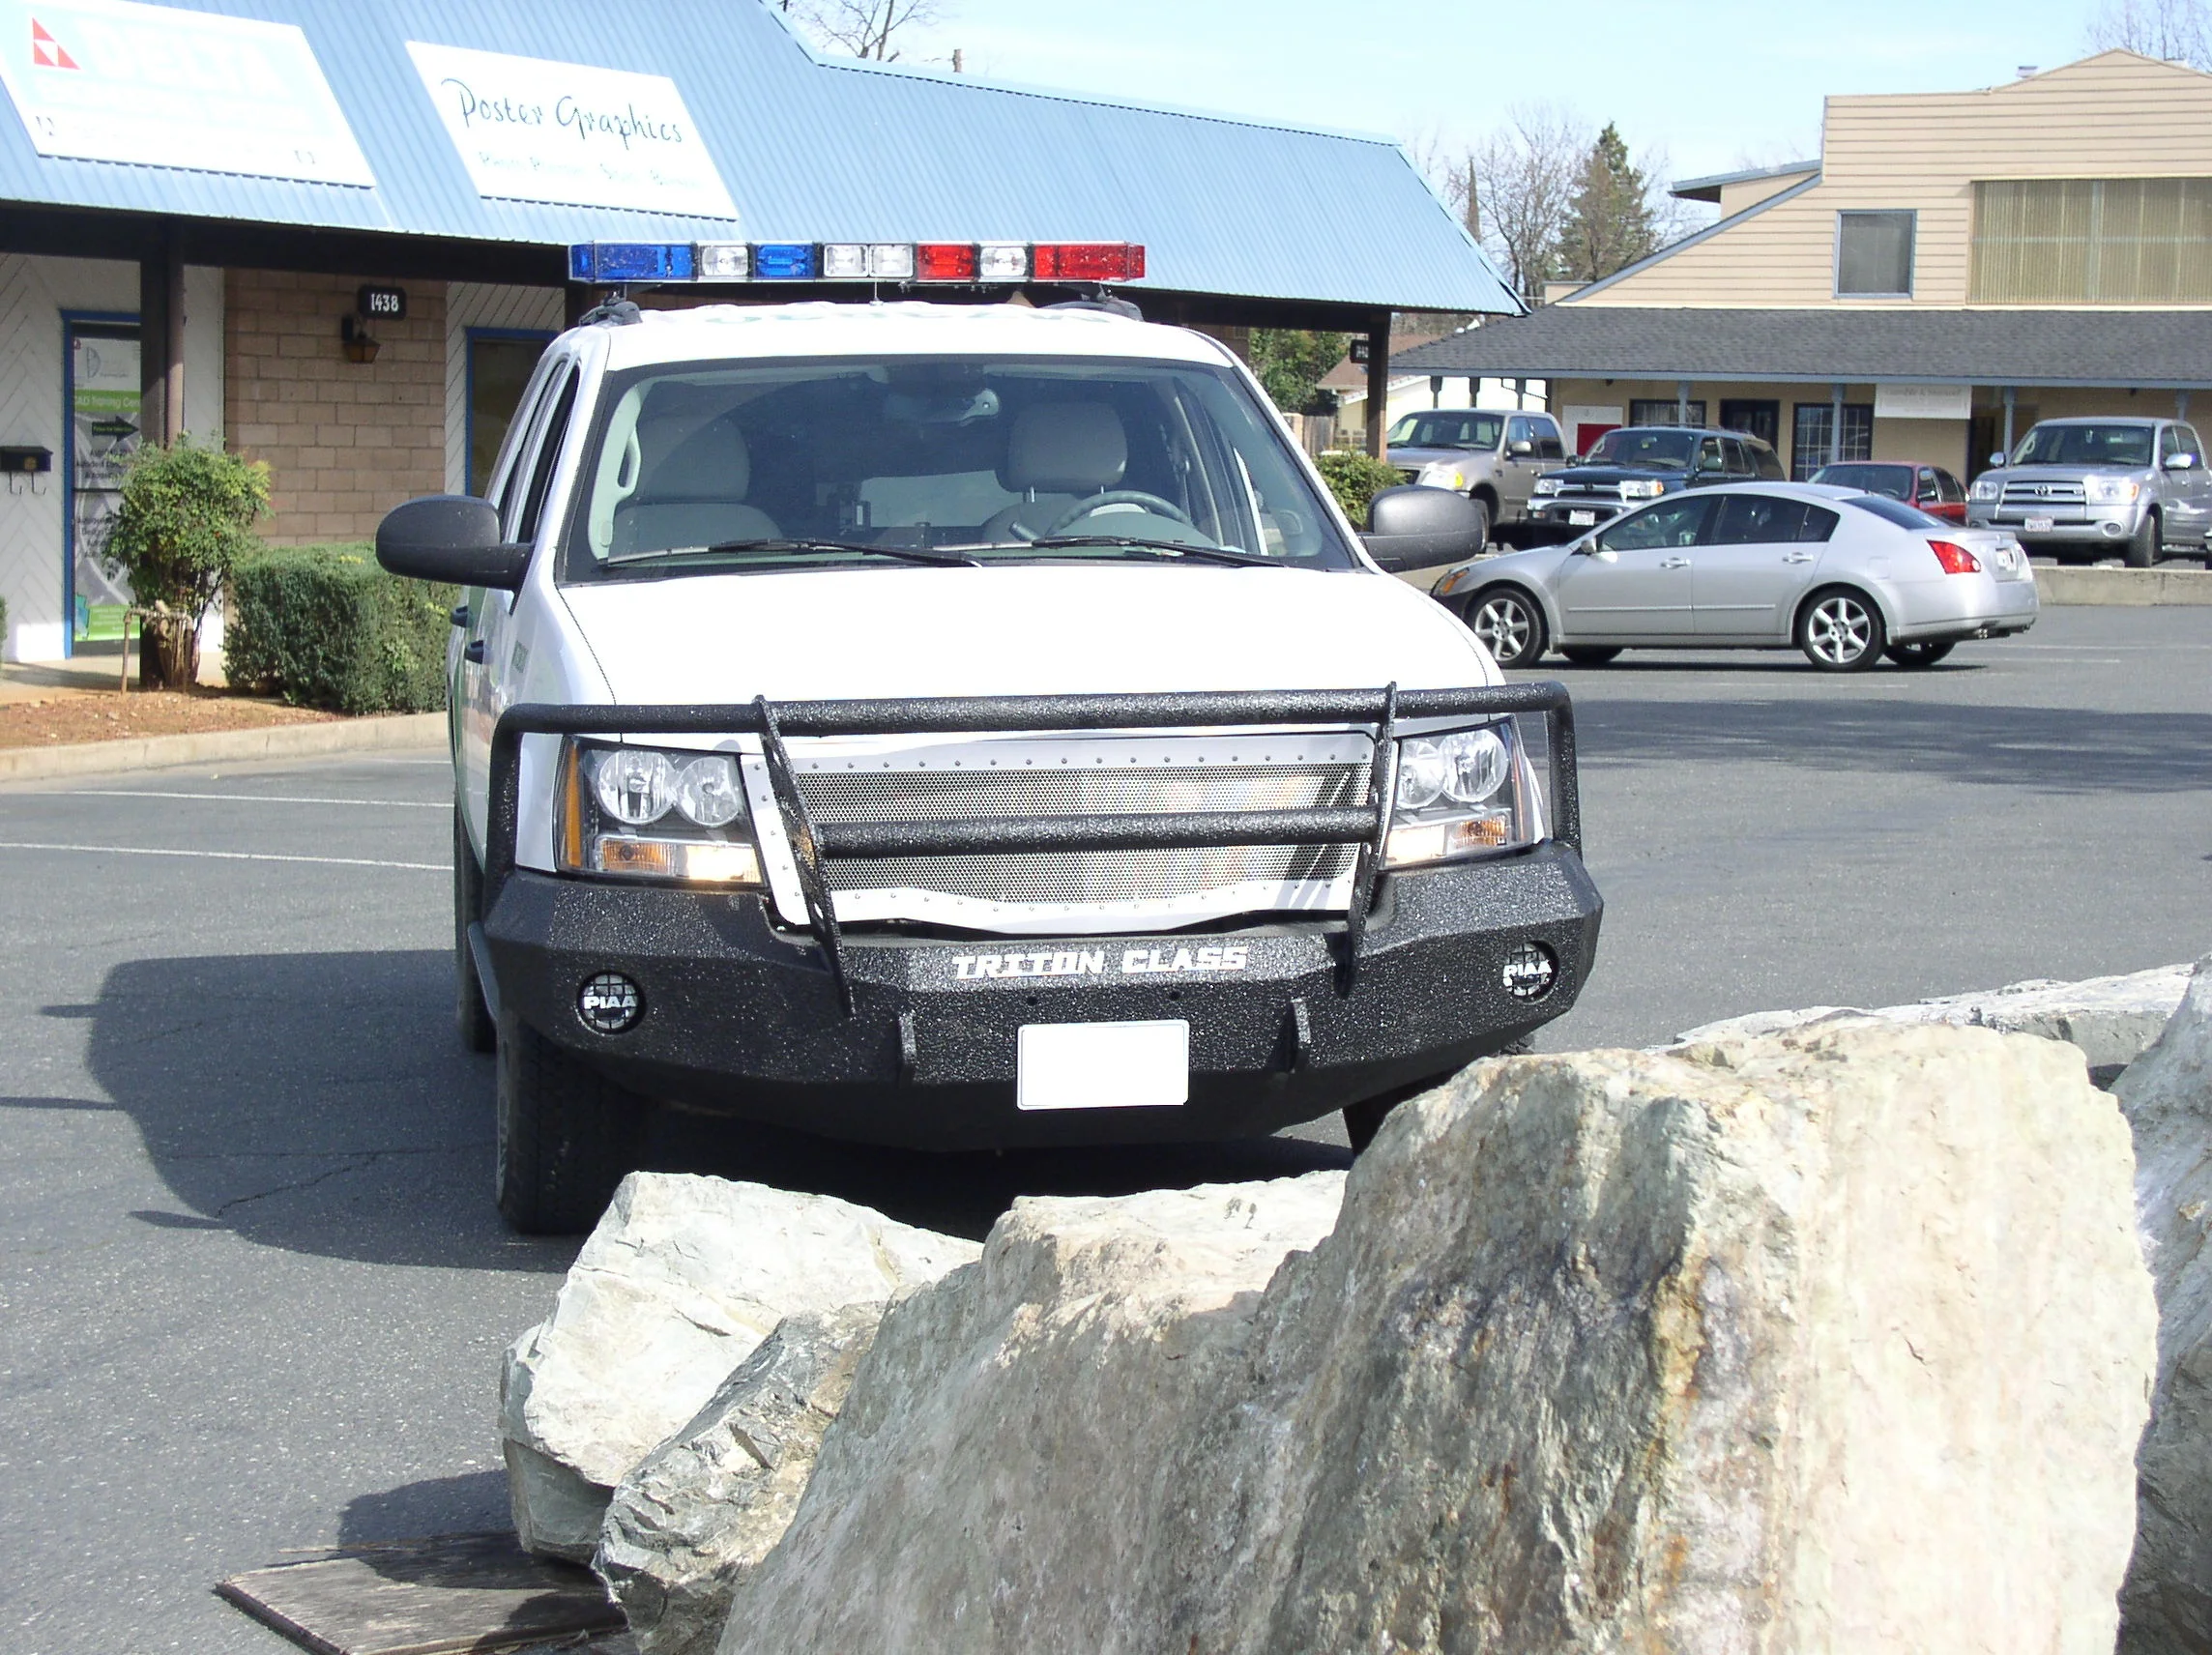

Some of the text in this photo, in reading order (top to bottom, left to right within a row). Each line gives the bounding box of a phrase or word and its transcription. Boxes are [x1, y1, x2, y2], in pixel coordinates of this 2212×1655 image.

[73, 16, 293, 100] DELTA
[440, 77, 683, 151] Poster Graphics
[370, 293, 399, 312] 1438
[952, 945, 1248, 979] TRITON CLASS
[1502, 960, 1553, 978] PIAA
[583, 996, 637, 1010] PIAA
